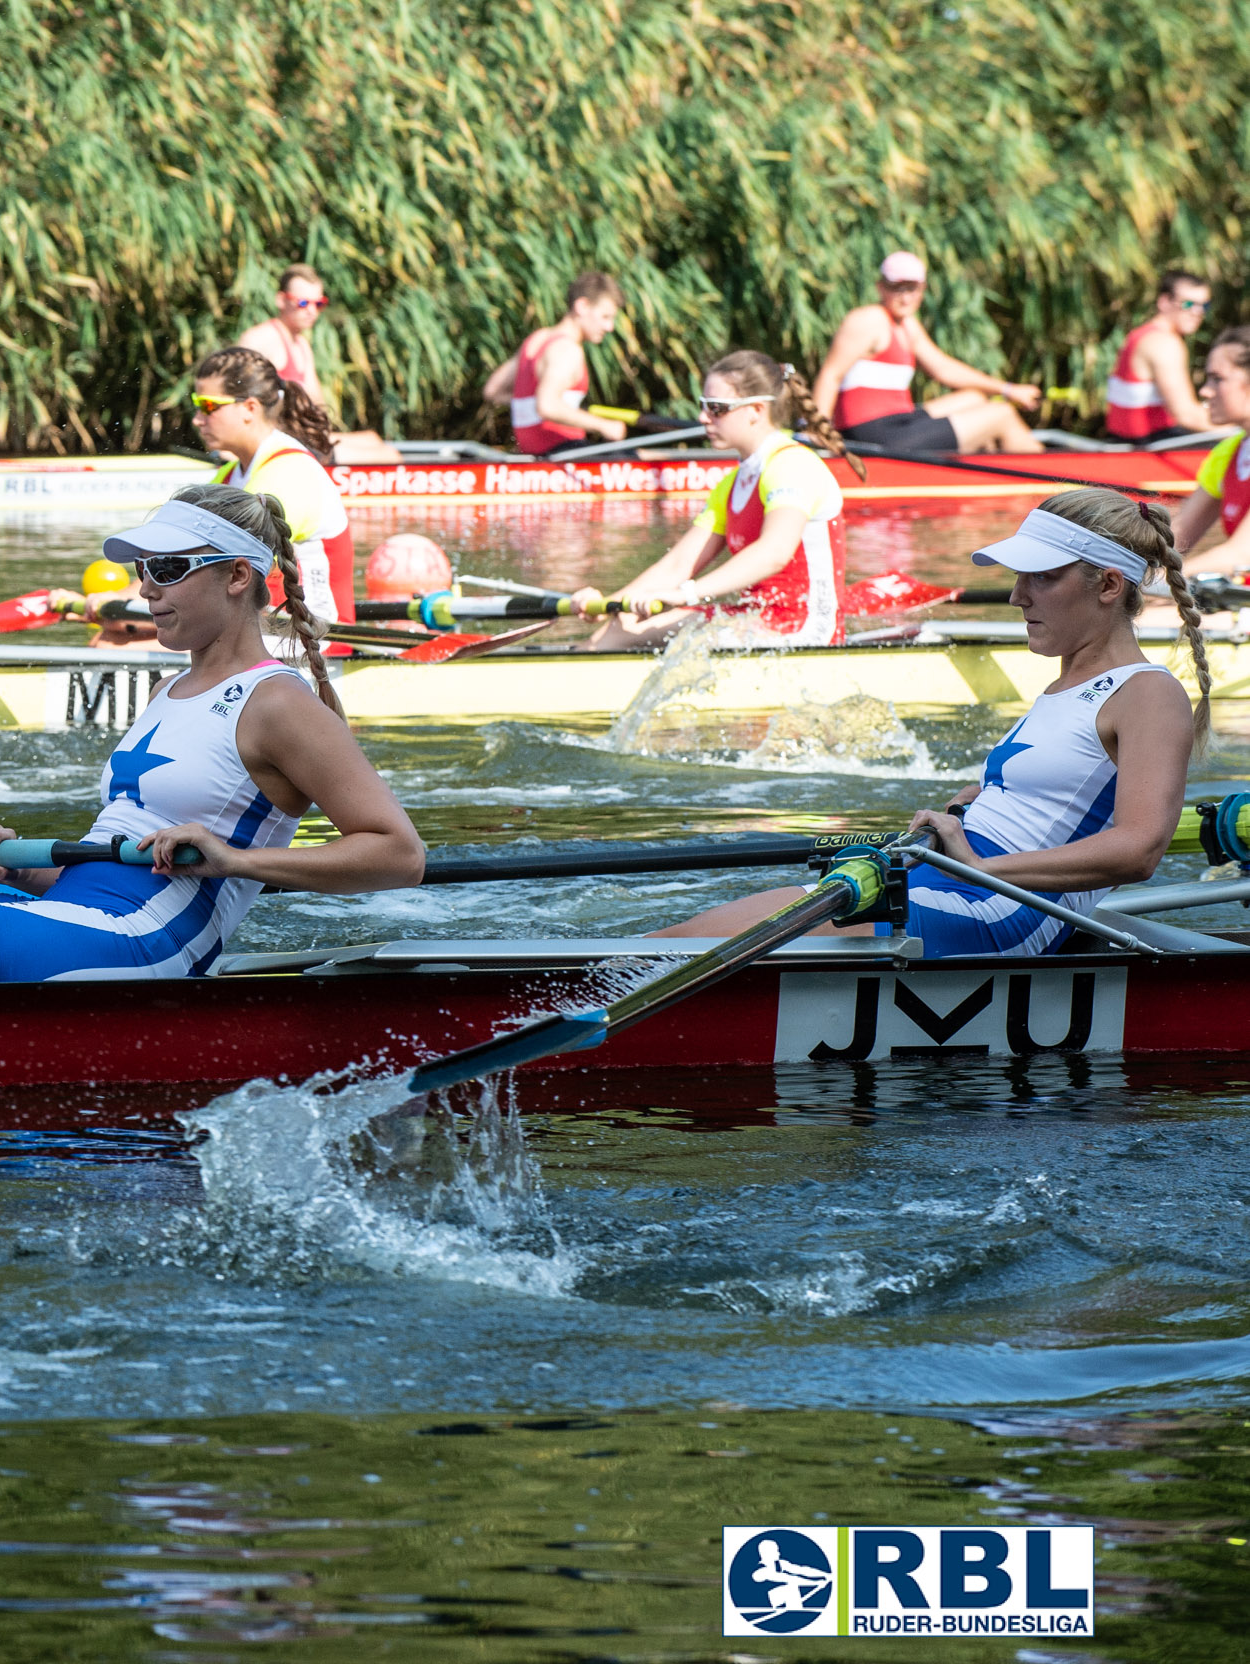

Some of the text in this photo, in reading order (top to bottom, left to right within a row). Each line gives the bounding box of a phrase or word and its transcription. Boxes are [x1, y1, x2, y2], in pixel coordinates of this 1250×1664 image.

[3, 478, 52, 495] RBL
[332, 464, 477, 496] Sparkasse
[1079, 691, 1096, 702] RBL
[211, 703, 228, 716] RBL
[808, 972, 1096, 1061] JMU
